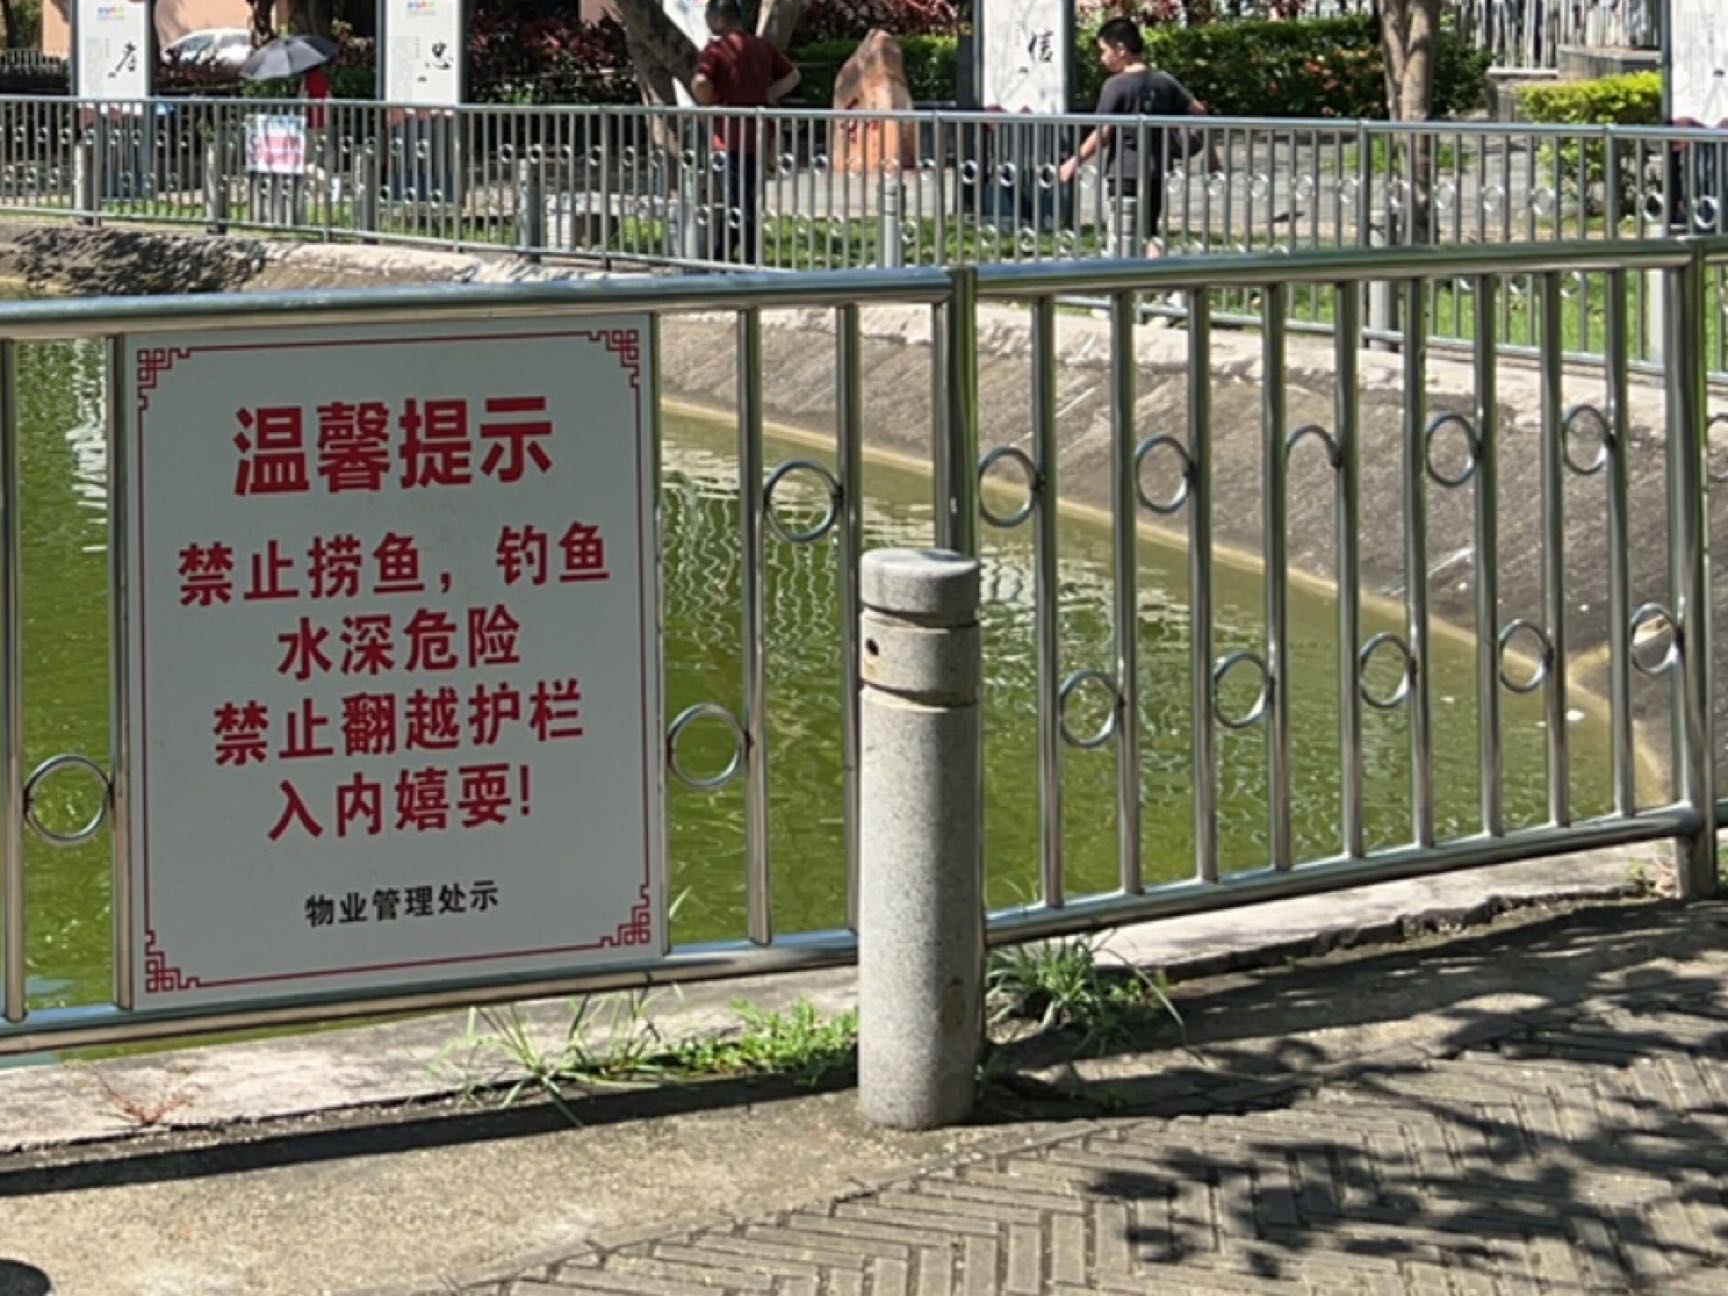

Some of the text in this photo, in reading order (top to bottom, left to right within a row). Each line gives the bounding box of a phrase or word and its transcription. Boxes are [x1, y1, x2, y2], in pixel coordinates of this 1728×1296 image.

[233, 395, 553, 497] 温馨提示
[277, 604, 520, 681] 水深危险
[213, 677, 583, 766] 禁止翻越护栏
[304, 879, 499, 928] 物业管理处示
